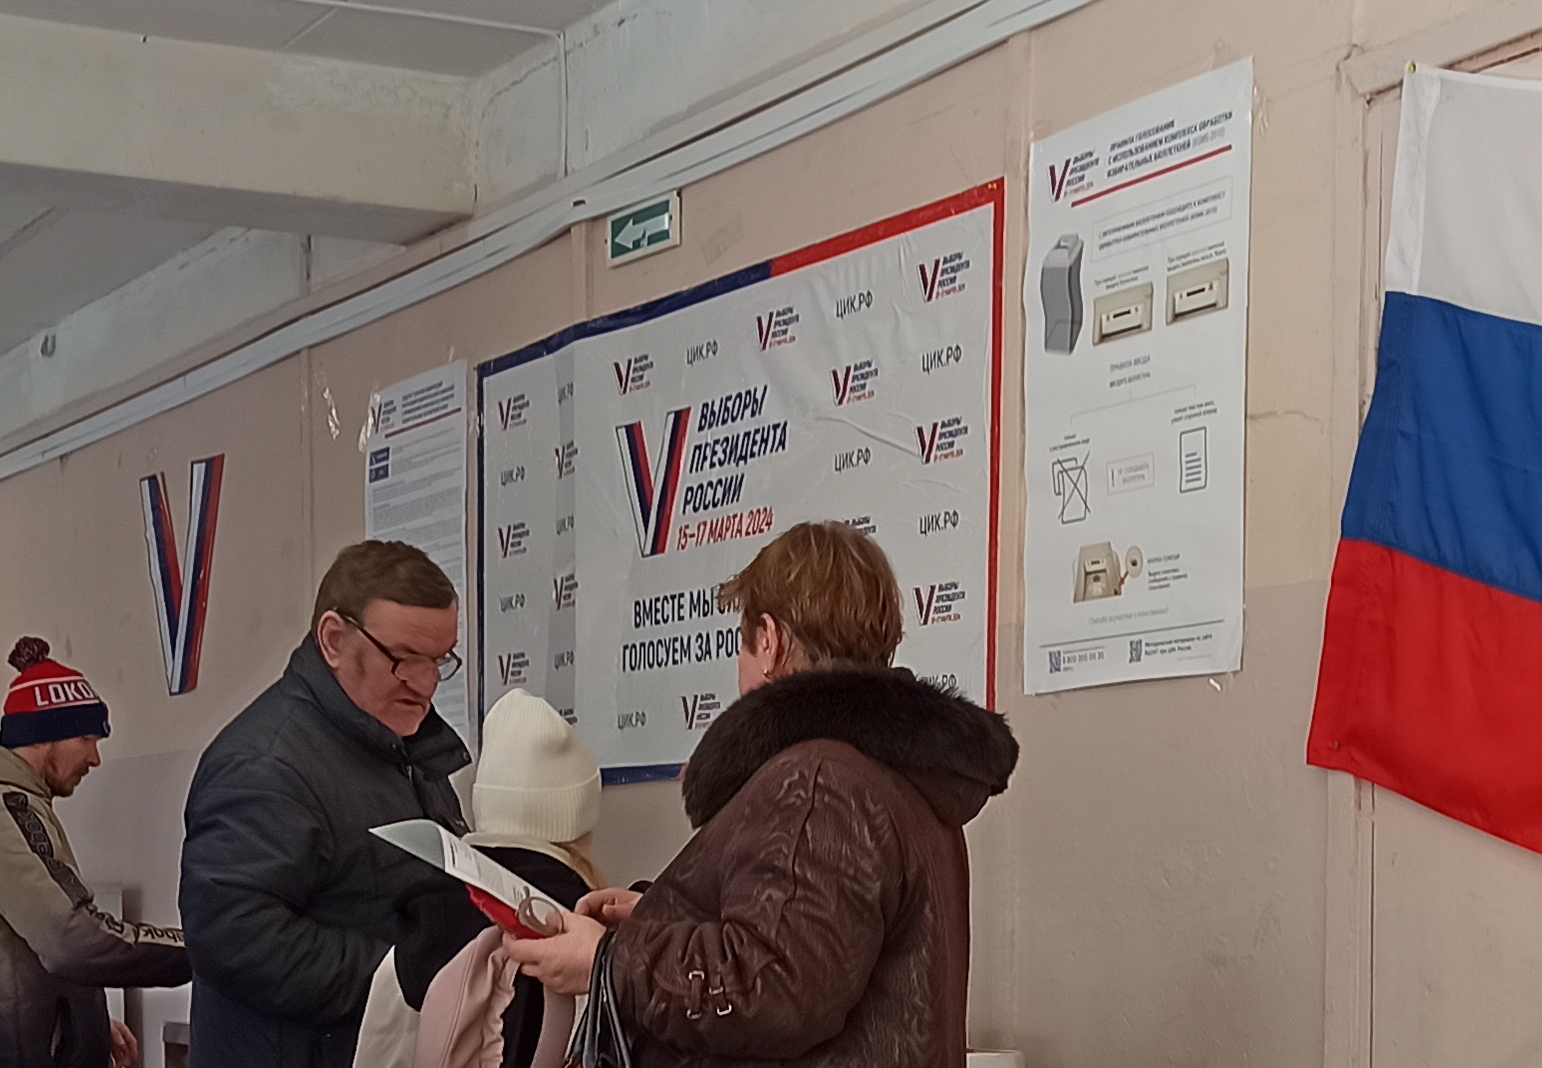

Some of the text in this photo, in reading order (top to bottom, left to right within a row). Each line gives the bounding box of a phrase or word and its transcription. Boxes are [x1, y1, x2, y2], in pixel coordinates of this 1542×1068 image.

[836, 290, 873, 319] ЦИК.РФ
[922, 345, 962, 374] ЦИК.РФ
[698, 384, 768, 432] ВЫБОРЫ
[689, 420, 788, 474] ПРЕЗИДЕНТА
[834, 447, 871, 474] ЦИК.РФ
[682, 473, 745, 515] РОССИИ
[707, 513, 743, 544] МАРТА
[745, 506, 774, 537] 2024
[919, 510, 959, 536] ЦИК.РФ
[633, 592, 685, 628] ВМЕСТЕ
[689, 587, 714, 619] МЫ
[622, 626, 741, 673] ГОЛОСУЕМ ЗА РОС
[34, 681, 95, 706] LOKO
